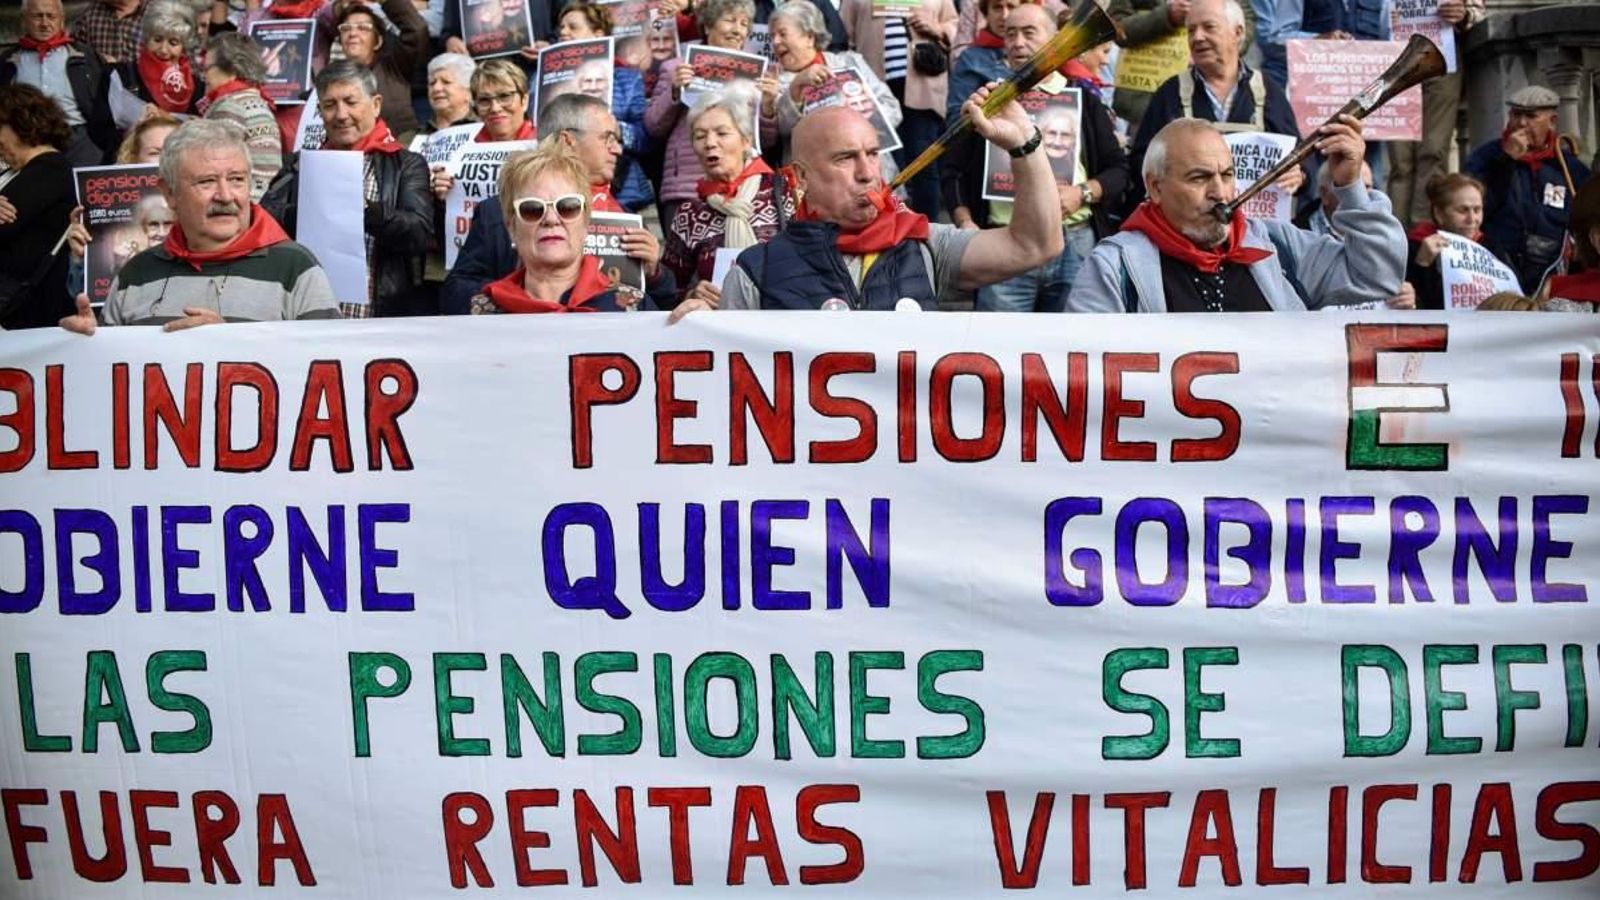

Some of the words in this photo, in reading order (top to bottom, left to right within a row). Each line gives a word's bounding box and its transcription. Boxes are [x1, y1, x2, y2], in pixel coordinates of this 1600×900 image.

[461, 151, 510, 161] PENSION
[1231, 144, 1261, 156] NCA
[1265, 146, 1282, 160] UN
[455, 163, 502, 180] JUST
[1252, 157, 1275, 170] TAN
[1237, 168, 1263, 180] BRE
[86, 174, 160, 193] pensione
[462, 182, 482, 197] YA
[87, 190, 141, 208] dignas
[568, 351, 1241, 469] PENSIONES
[1345, 323, 1450, 472] E
[542, 498, 891, 620] QUIEN
[1044, 495, 1590, 608] GOBIERNE
[15, 650, 213, 753] LAS
[348, 650, 986, 760] PENSIONES
[1101, 646, 1242, 760] SE
[1341, 643, 1600, 758] DEFI
[0, 788, 318, 887] FUERA
[441, 785, 865, 889] RENTAS
[986, 780, 1600, 891] VITALICIAS
